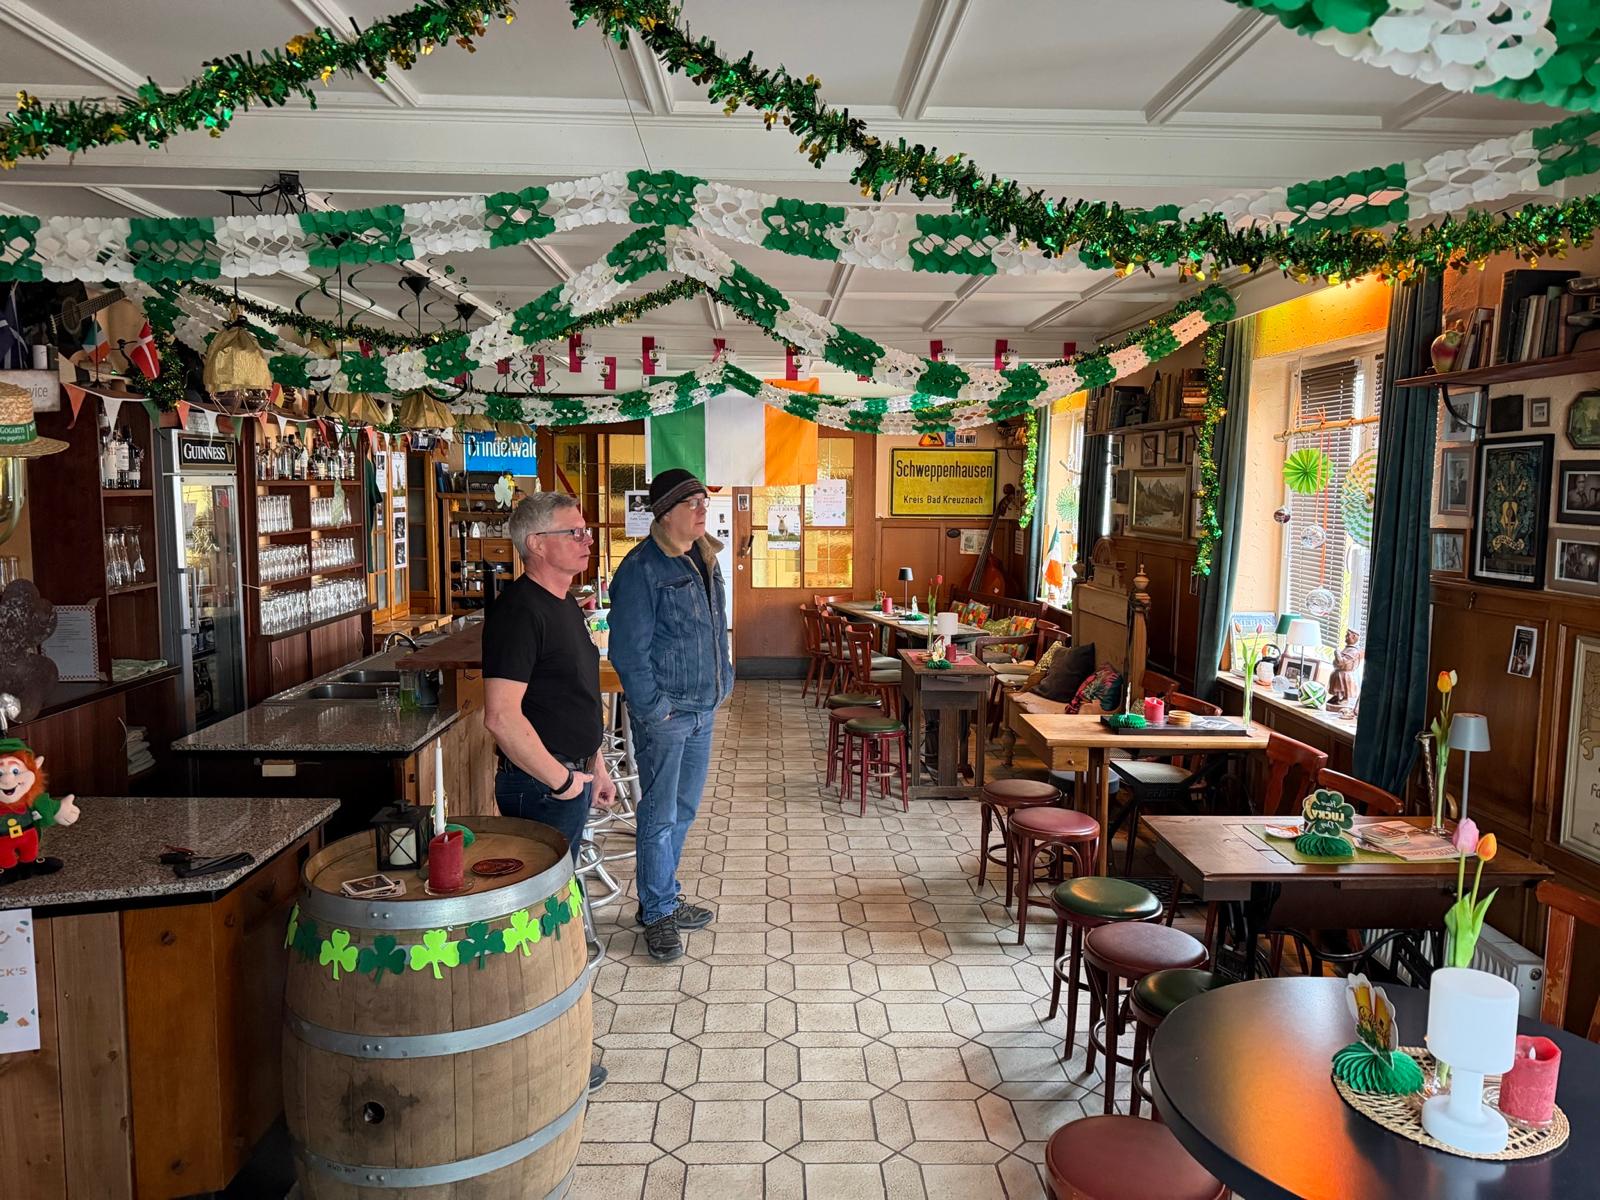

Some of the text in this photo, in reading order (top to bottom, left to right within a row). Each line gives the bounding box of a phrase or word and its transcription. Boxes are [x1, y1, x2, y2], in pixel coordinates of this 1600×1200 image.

[32, 384, 48, 398] vice
[956, 434, 976, 444] GALWAY
[184, 443, 226, 460] GUINNESS
[896, 460, 993, 482] Schweppenhausen
[903, 495, 984, 505] Kreis Bad Kreuznach
